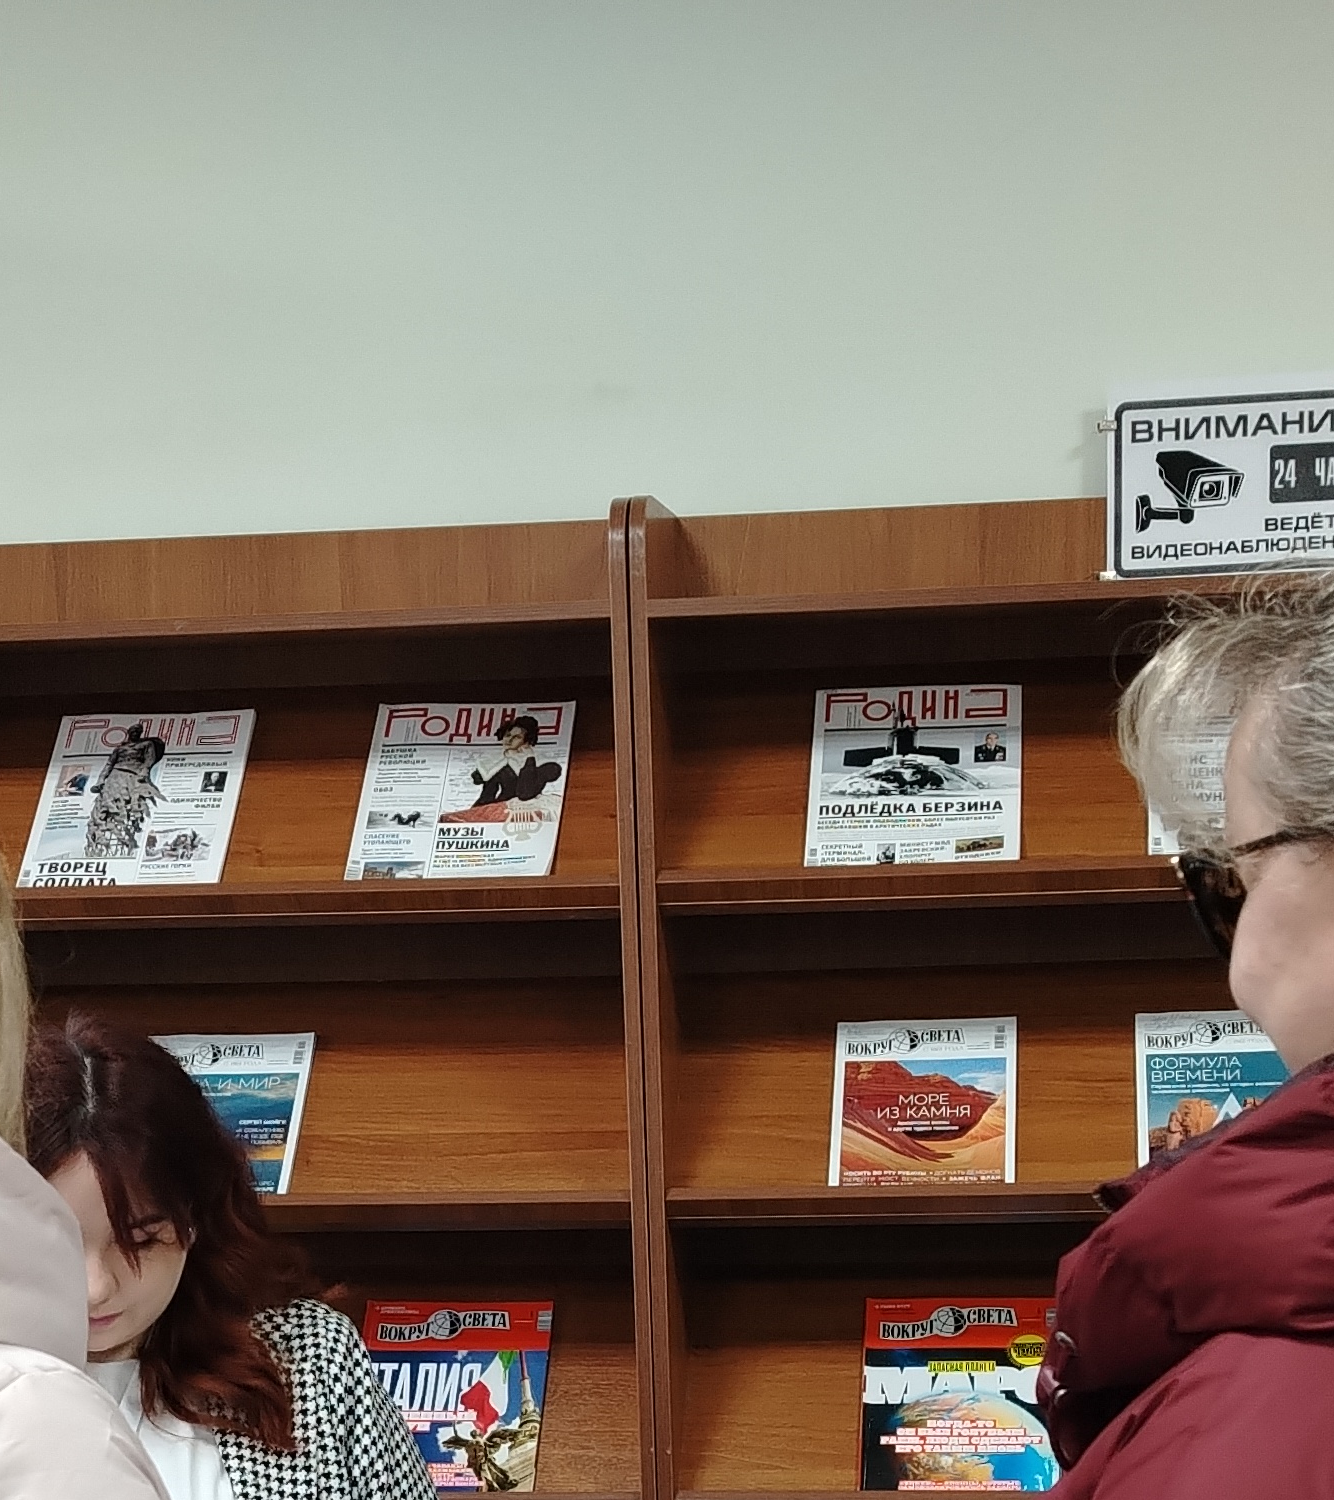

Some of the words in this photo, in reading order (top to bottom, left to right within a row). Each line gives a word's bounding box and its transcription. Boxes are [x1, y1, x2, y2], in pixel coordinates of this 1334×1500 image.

[1274, 458, 1297, 489] 24
[818, 801, 917, 817] ПОДЛЁДКА
[922, 800, 1004, 813] БЕРЗИНА
[438, 827, 485, 837] МУЗЫ
[435, 839, 510, 850] ПУШКИНА
[37, 861, 108, 876] ТВОРЕЦ
[847, 1038, 896, 1055] ВОКРУГ
[921, 1029, 961, 1043] СВЕТА
[1147, 1031, 1196, 1048] ВОКРУГ
[223, 1044, 261, 1058] СВЕТА
[1150, 1055, 1243, 1070] ФОРМУЛА
[239, 1076, 281, 1090] МИР
[1151, 1069, 1241, 1083] ВРЕМЕНИ
[899, 1093, 950, 1106] МОРЕ
[877, 1106, 900, 1119] ИЗ
[907, 1105, 971, 1119] КАМНЯ
[379, 1321, 434, 1340] ВОКРУГ
[463, 1312, 507, 1328] СВЕТА
[882, 1318, 937, 1339] ВОКРУГ
[966, 1308, 1014, 1324] СВЕТА
[372, 1362, 482, 1412] ТАЛИЯ
